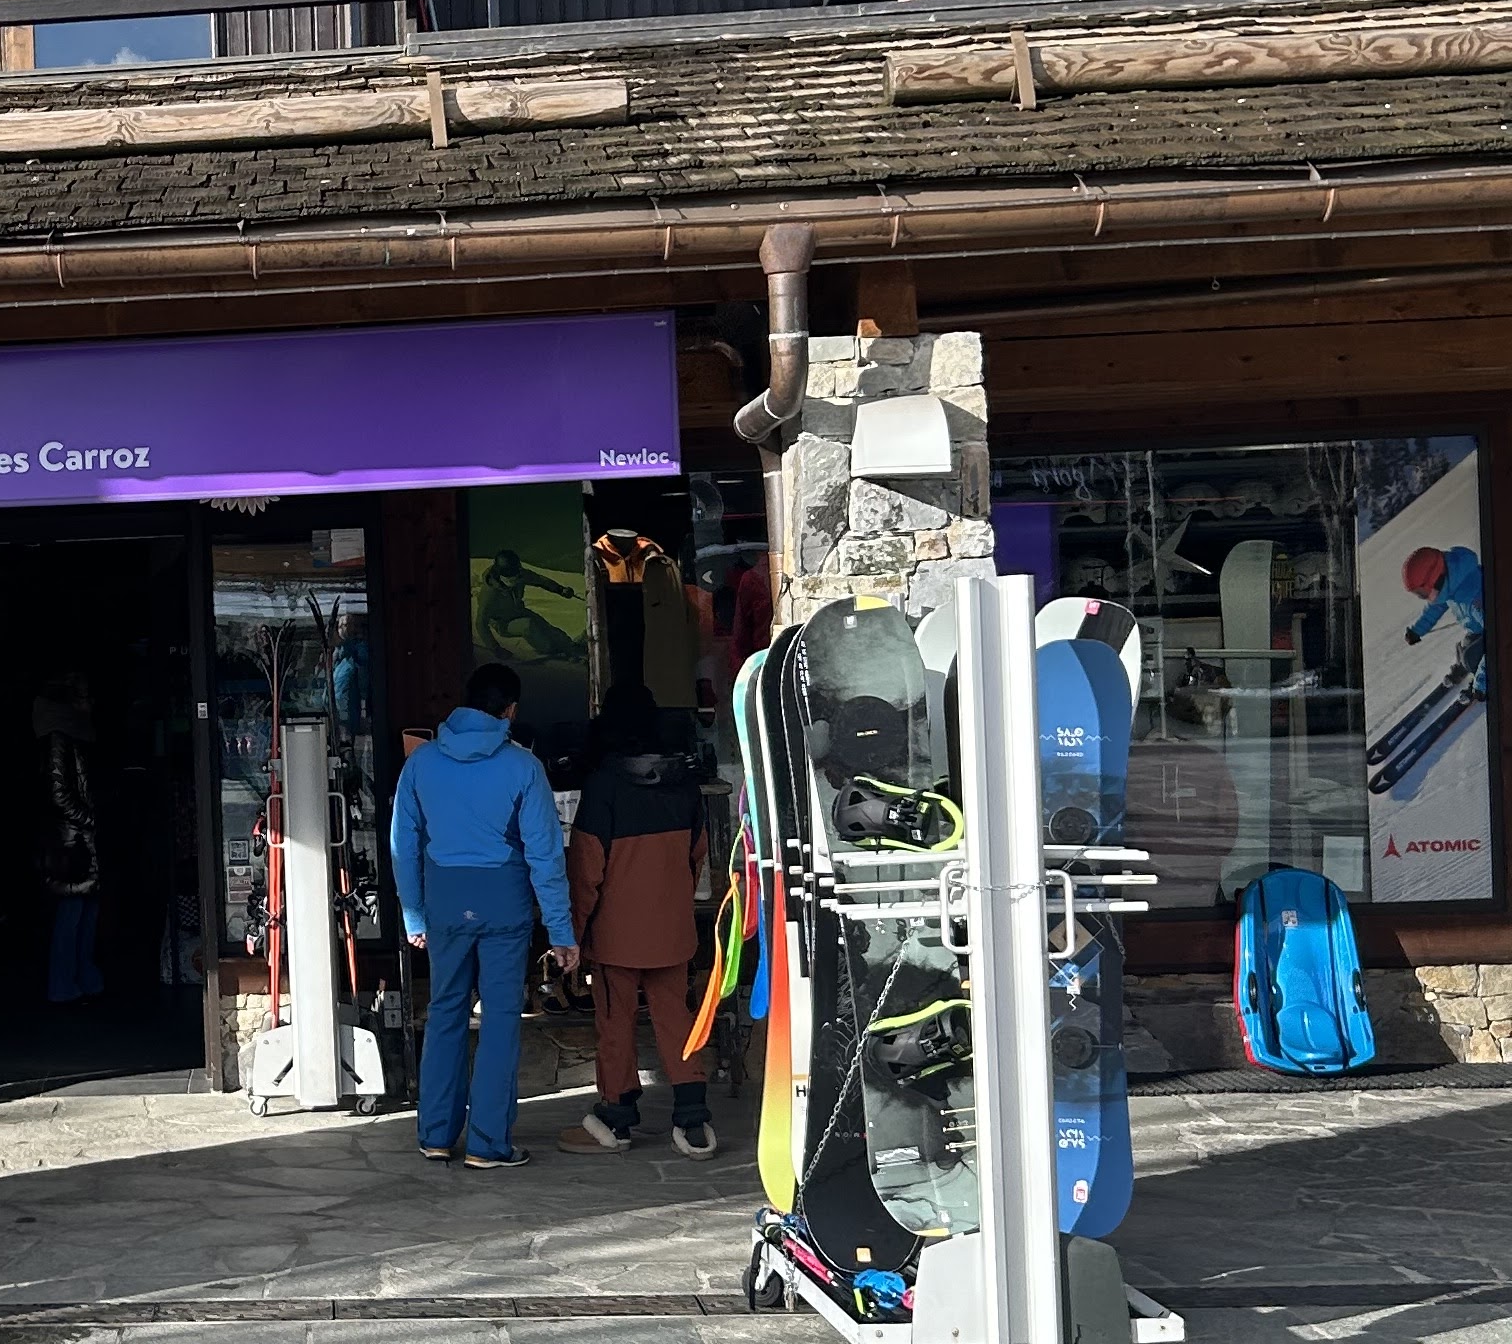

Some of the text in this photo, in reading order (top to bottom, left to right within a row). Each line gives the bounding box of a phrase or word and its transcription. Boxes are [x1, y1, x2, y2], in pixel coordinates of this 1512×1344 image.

[38, 440, 149, 474] Carroz
[599, 447, 669, 467] Newloc
[1405, 838, 1481, 854] ATOMIC
